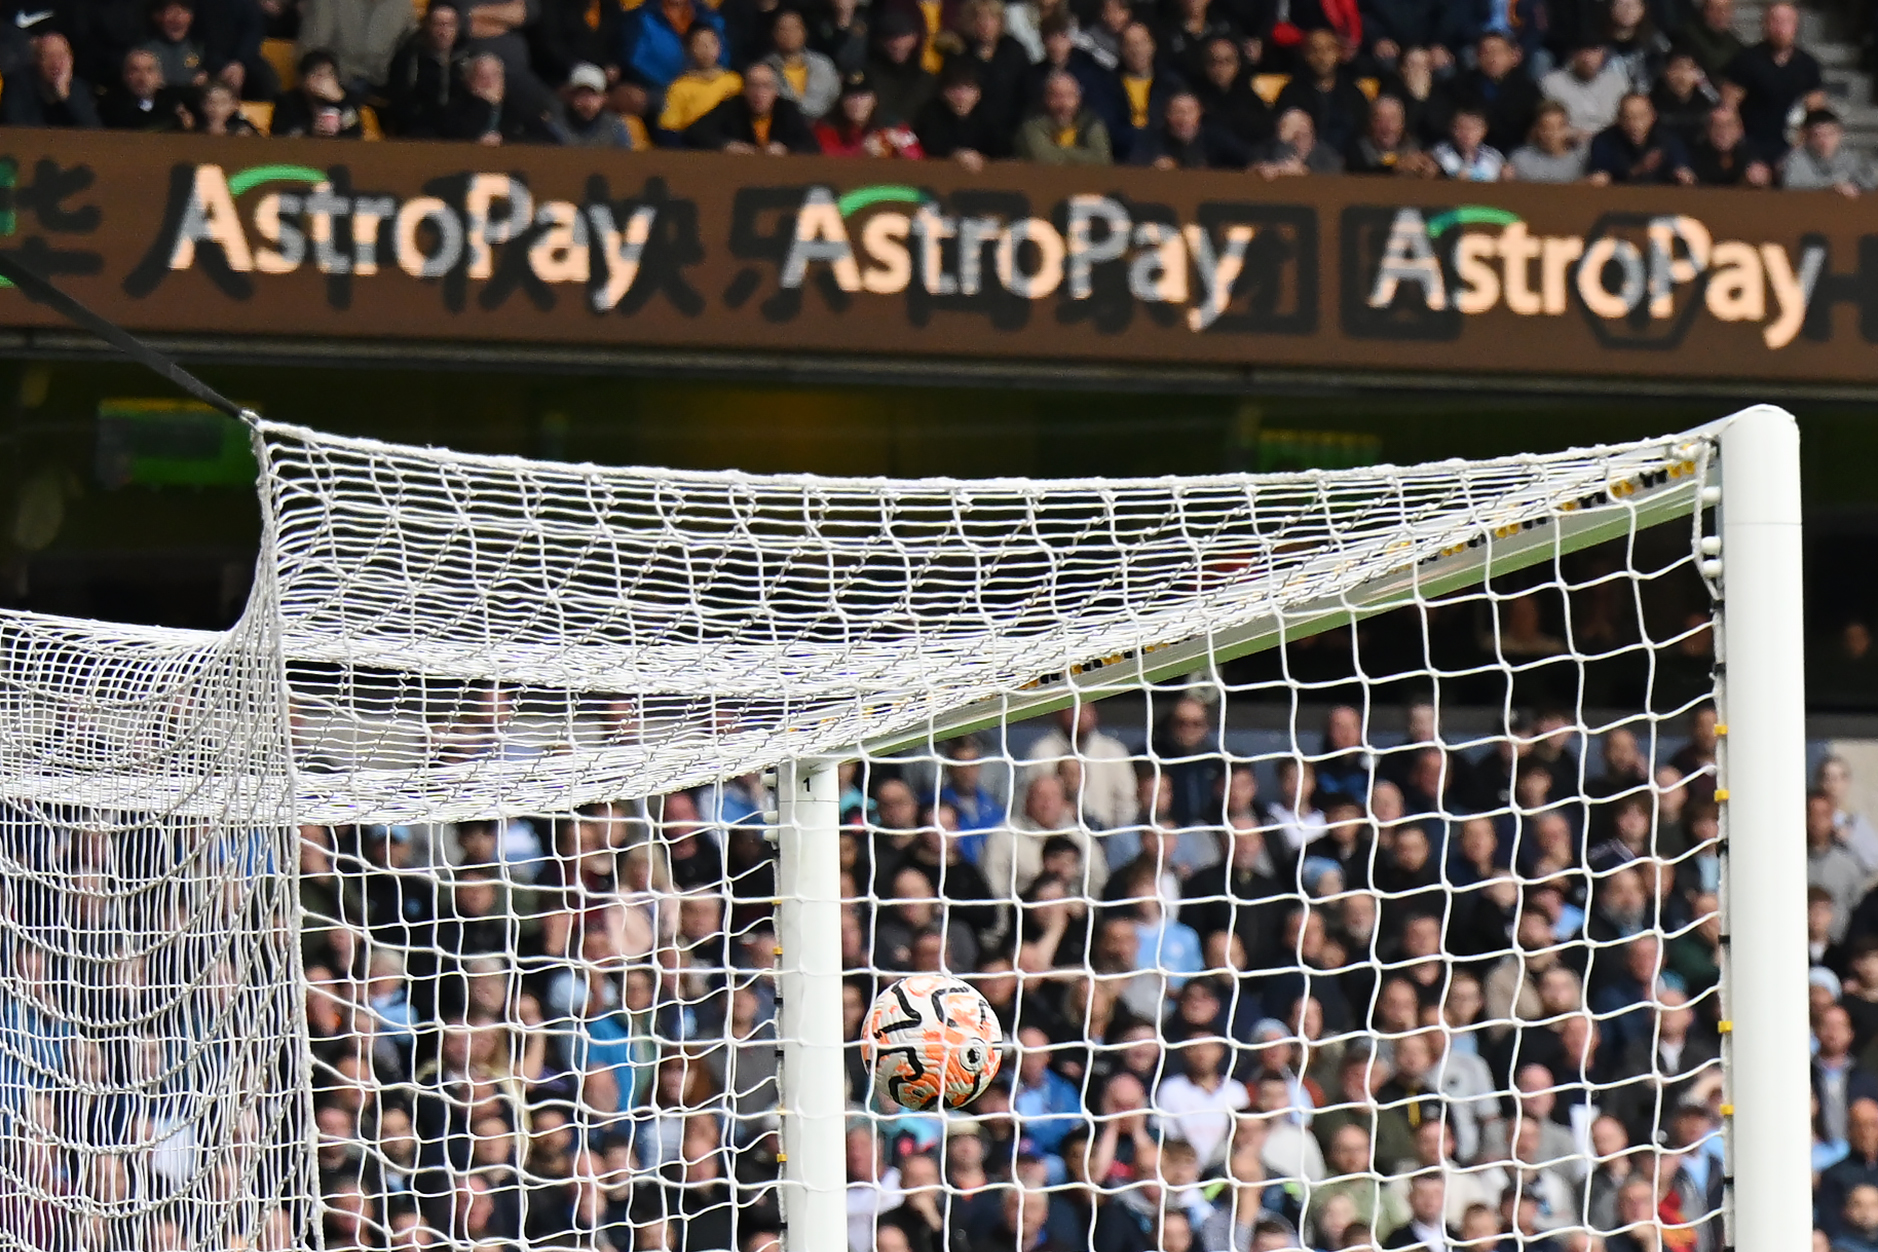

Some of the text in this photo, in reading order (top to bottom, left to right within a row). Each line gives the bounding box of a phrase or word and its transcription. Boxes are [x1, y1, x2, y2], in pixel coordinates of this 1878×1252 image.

[169, 163, 654, 310] AstroPay
[783, 186, 1254, 332] AstroPay
[1370, 206, 1823, 349] AstroPay
[802, 777, 811, 792] 1
